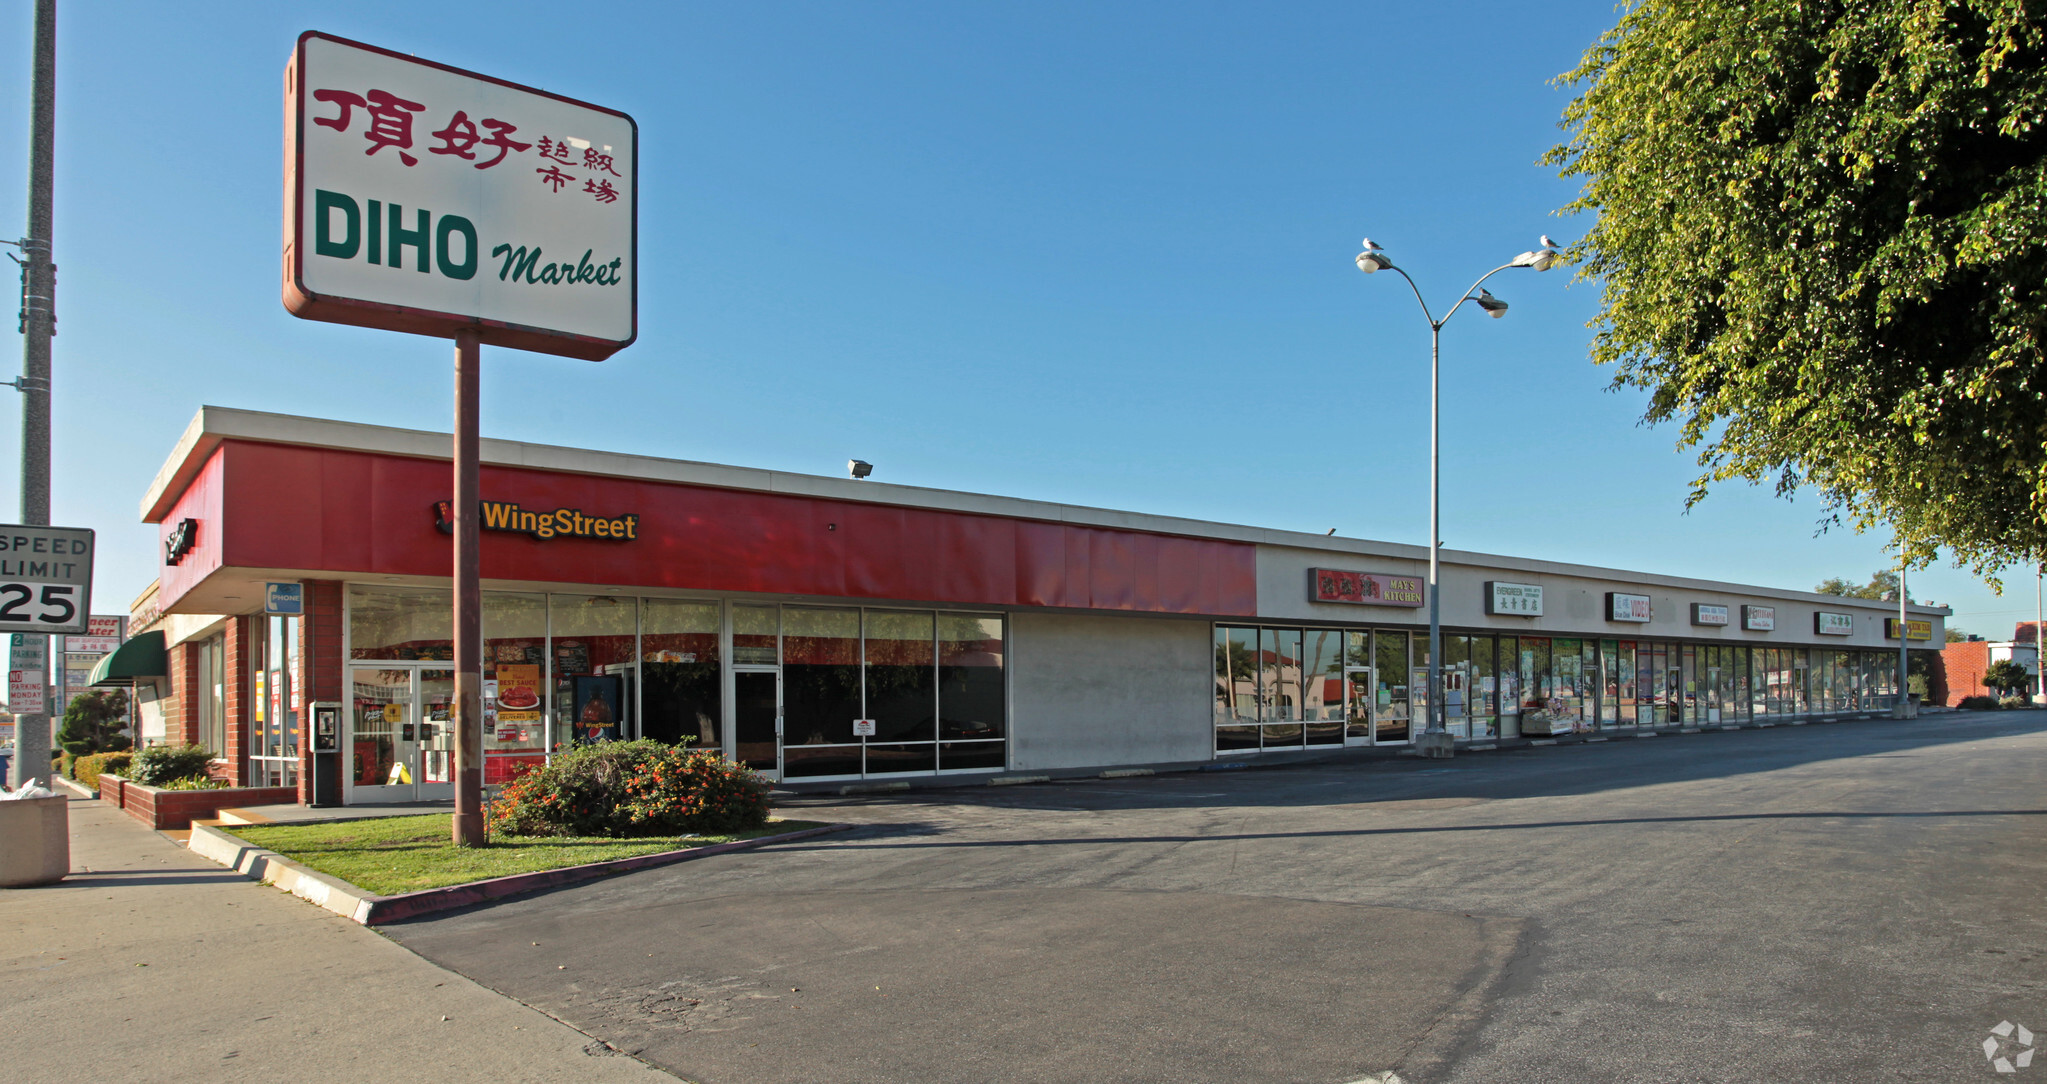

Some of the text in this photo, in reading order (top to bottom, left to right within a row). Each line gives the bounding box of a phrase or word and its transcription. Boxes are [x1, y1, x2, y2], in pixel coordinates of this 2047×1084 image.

[312, 88, 532, 170] 頂好
[536, 166, 620, 204] 市場
[315, 188, 622, 287] DIHO Market
[483, 501, 636, 539] WingStreet
[0, 535, 87, 555] SPEED
[2, 559, 76, 579] LIMIT
[1390, 579, 1415, 591] MAY'S
[1496, 586, 1523, 596] EVERGREEN
[272, 594, 301, 602] PHONE
[1384, 591, 1421, 603] KITCHEN
[0, 583, 75, 624] 25
[89, 618, 118, 626] neer
[14, 635, 21, 645] 2
[12, 650, 43, 658] PARKING
[10, 672, 22, 681] NO
